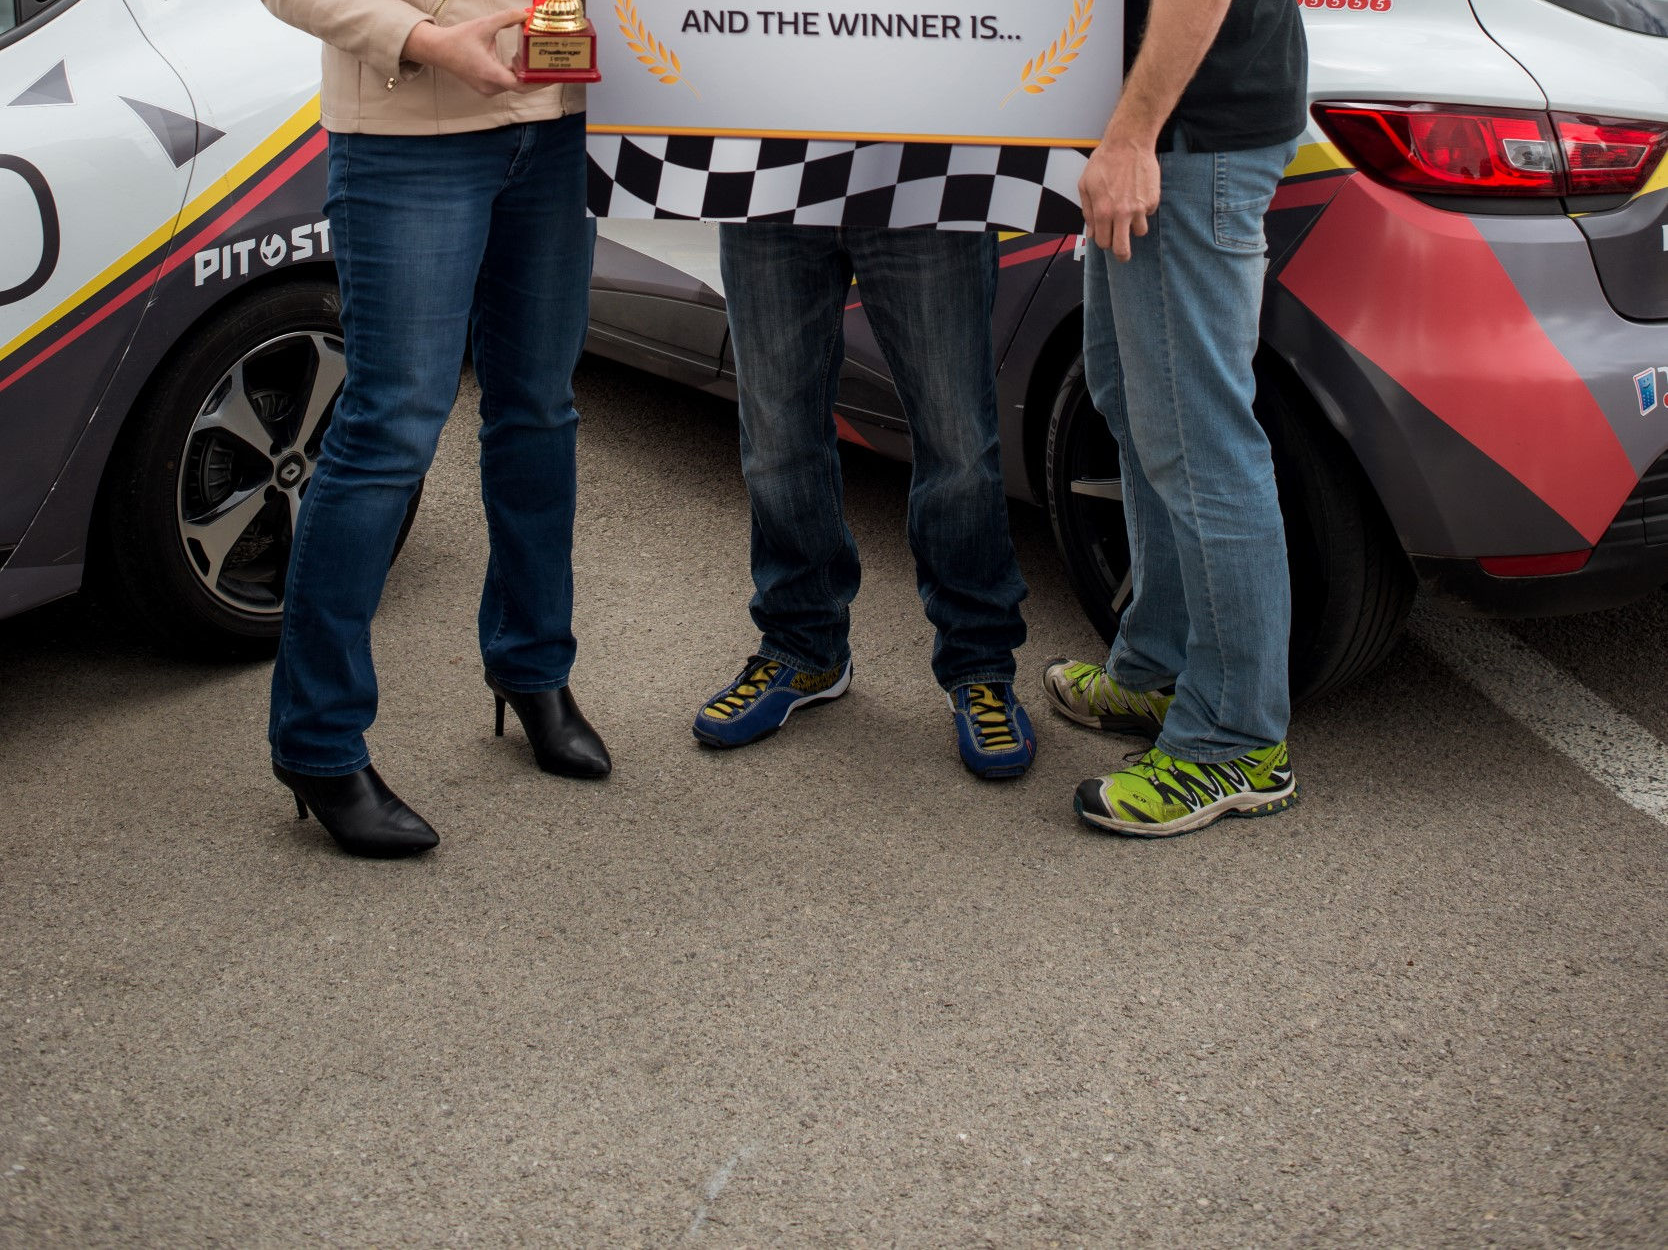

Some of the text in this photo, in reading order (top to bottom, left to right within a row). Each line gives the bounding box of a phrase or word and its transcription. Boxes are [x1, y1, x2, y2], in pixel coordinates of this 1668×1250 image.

[681, 10, 1022, 40] AND THE WINNER IS...
[194, 238, 256, 287] PIT
